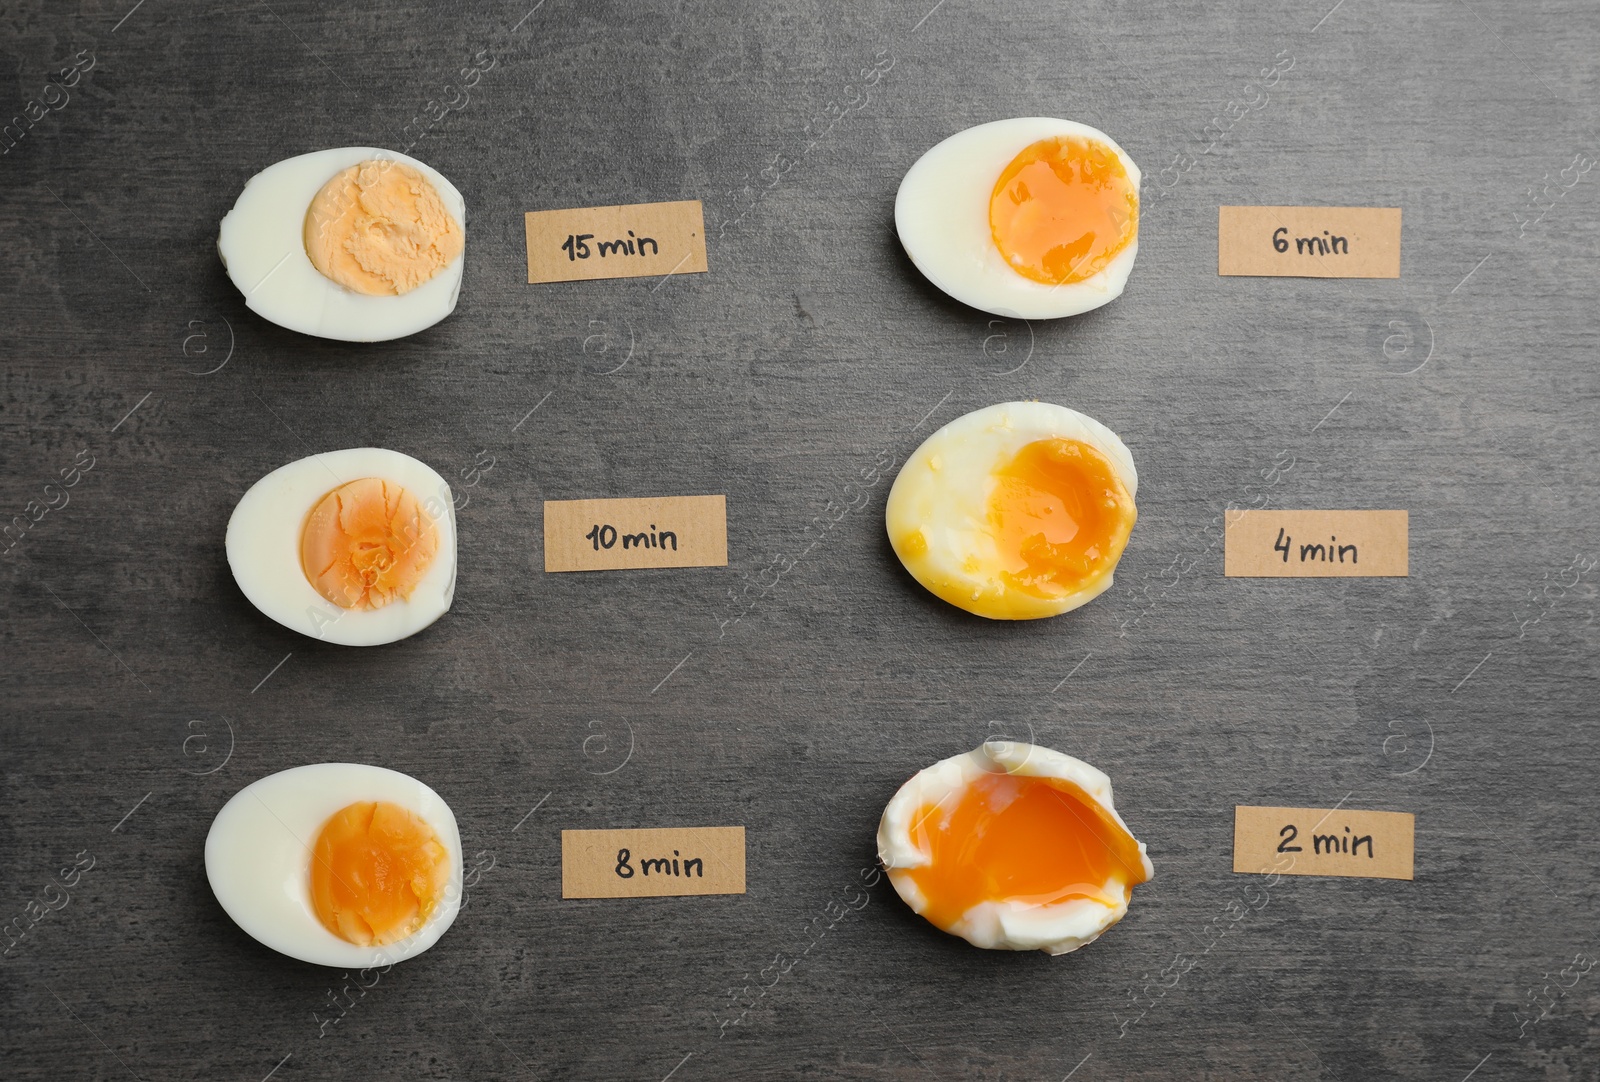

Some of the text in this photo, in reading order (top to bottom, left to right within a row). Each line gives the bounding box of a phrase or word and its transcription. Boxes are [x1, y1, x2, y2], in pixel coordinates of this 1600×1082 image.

[561, 230, 659, 262] 15 min
[1272, 227, 1348, 256] 6 min
[585, 524, 678, 551] 10 min
[1274, 527, 1357, 563] 4 min
[1276, 824, 1374, 859] 2 min
[614, 848, 704, 879] 8 min
